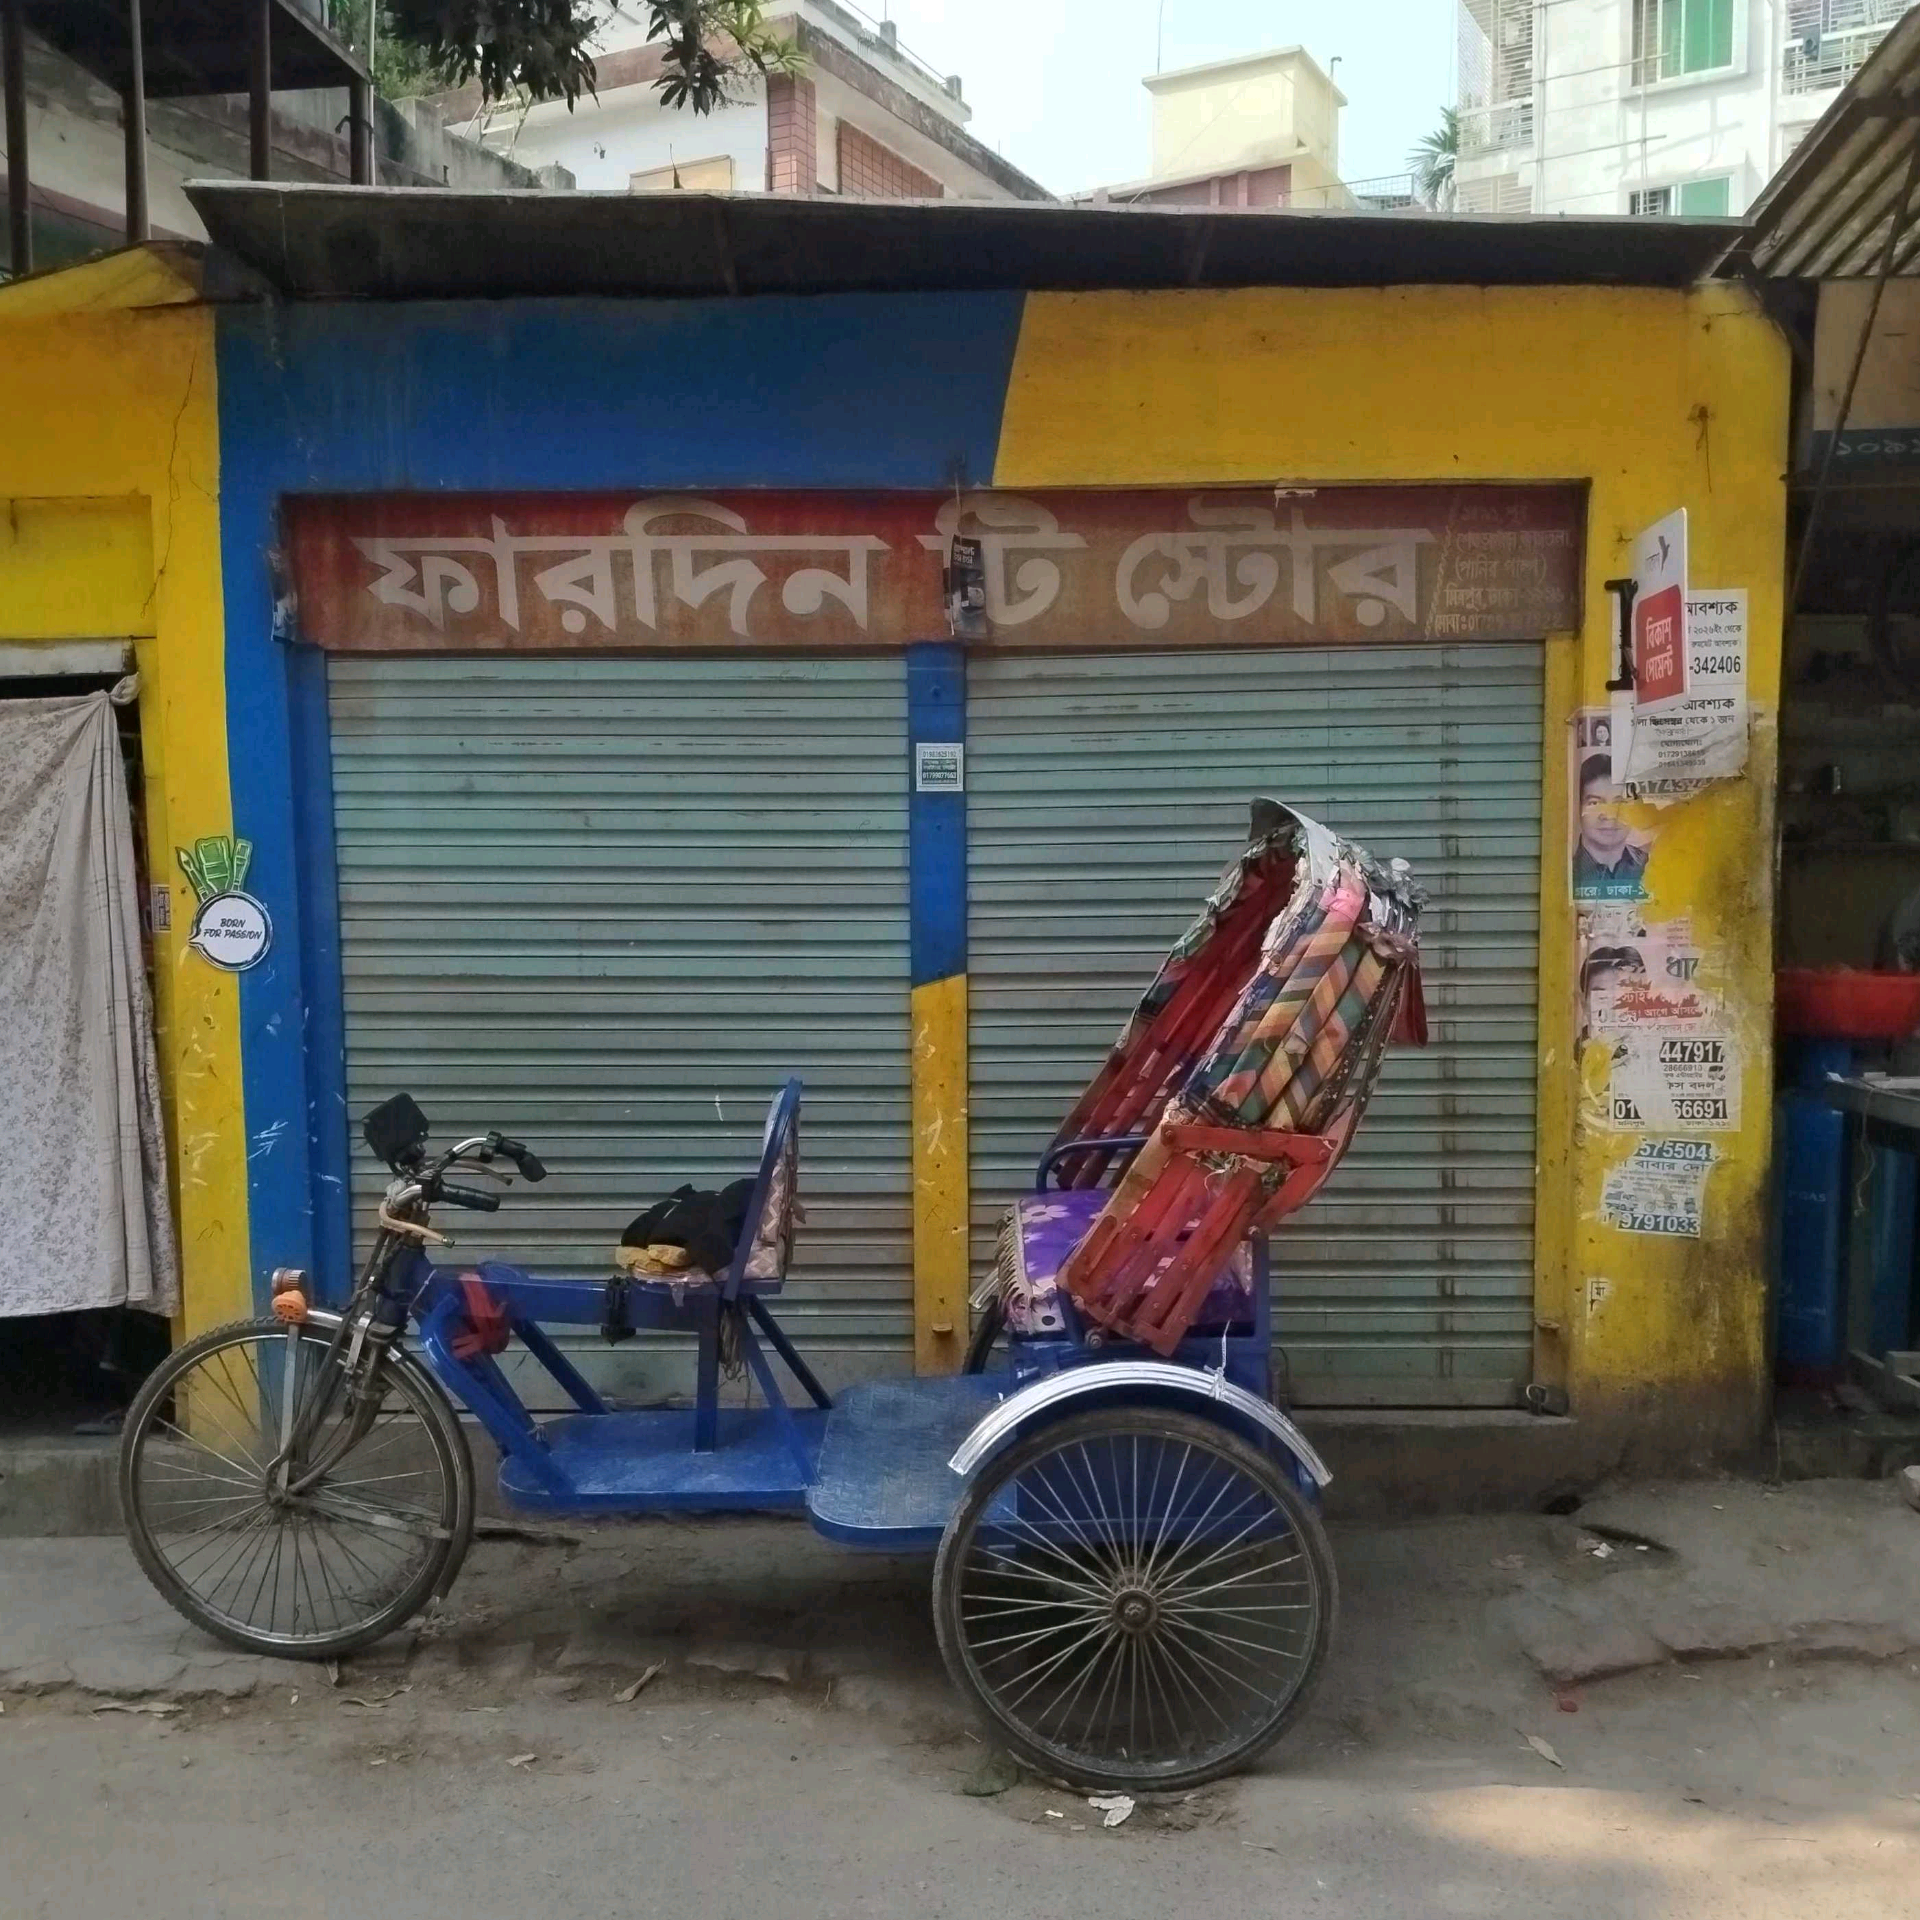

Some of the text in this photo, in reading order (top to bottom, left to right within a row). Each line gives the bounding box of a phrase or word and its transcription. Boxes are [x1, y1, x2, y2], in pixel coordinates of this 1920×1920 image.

[350, 495, 1436, 636] ফারদিন টি স্টোর
[1646, 616, 1673, 650] বিকাশ
[1724, 624, 1742, 635] থেকে
[1645, 645, 1674, 684] পেমেন্ট
[1689, 655, 1741, 675] -342406
[1682, 698, 1736, 711] আবশ্যক
[1685, 716, 1708, 726] থেকে
[219, 918, 246, 928] BORN
[203, 928, 262, 940] FOR PASSION
[1659, 1041, 1724, 1062] 447917
[1688, 1080, 1716, 1091] বদল
[1635, 1160, 1678, 1171] বাবার
